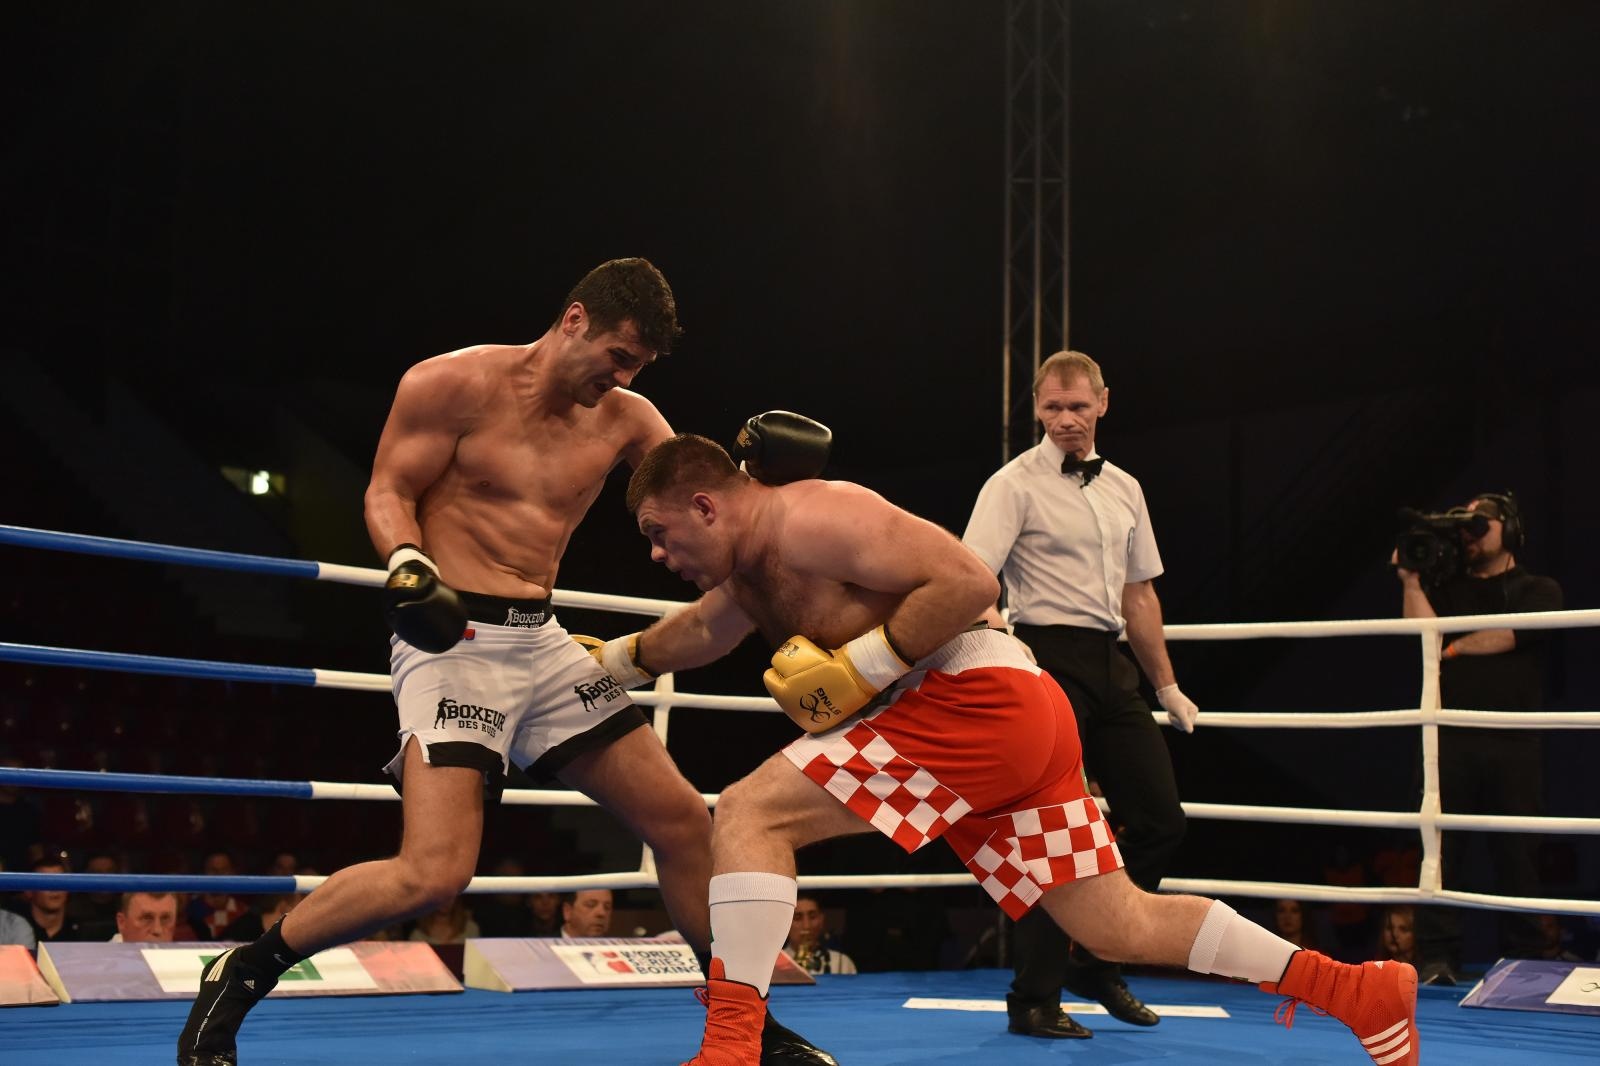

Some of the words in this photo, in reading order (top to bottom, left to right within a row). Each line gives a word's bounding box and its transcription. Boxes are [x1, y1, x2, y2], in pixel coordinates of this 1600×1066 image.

[512, 613, 545, 623] BOXEUR
[603, 688, 620, 702] DES
[817, 687, 842, 715] STING
[447, 705, 506, 732] BOXEUR
[458, 720, 478, 729] DES
[637, 966, 701, 974] BOXING
